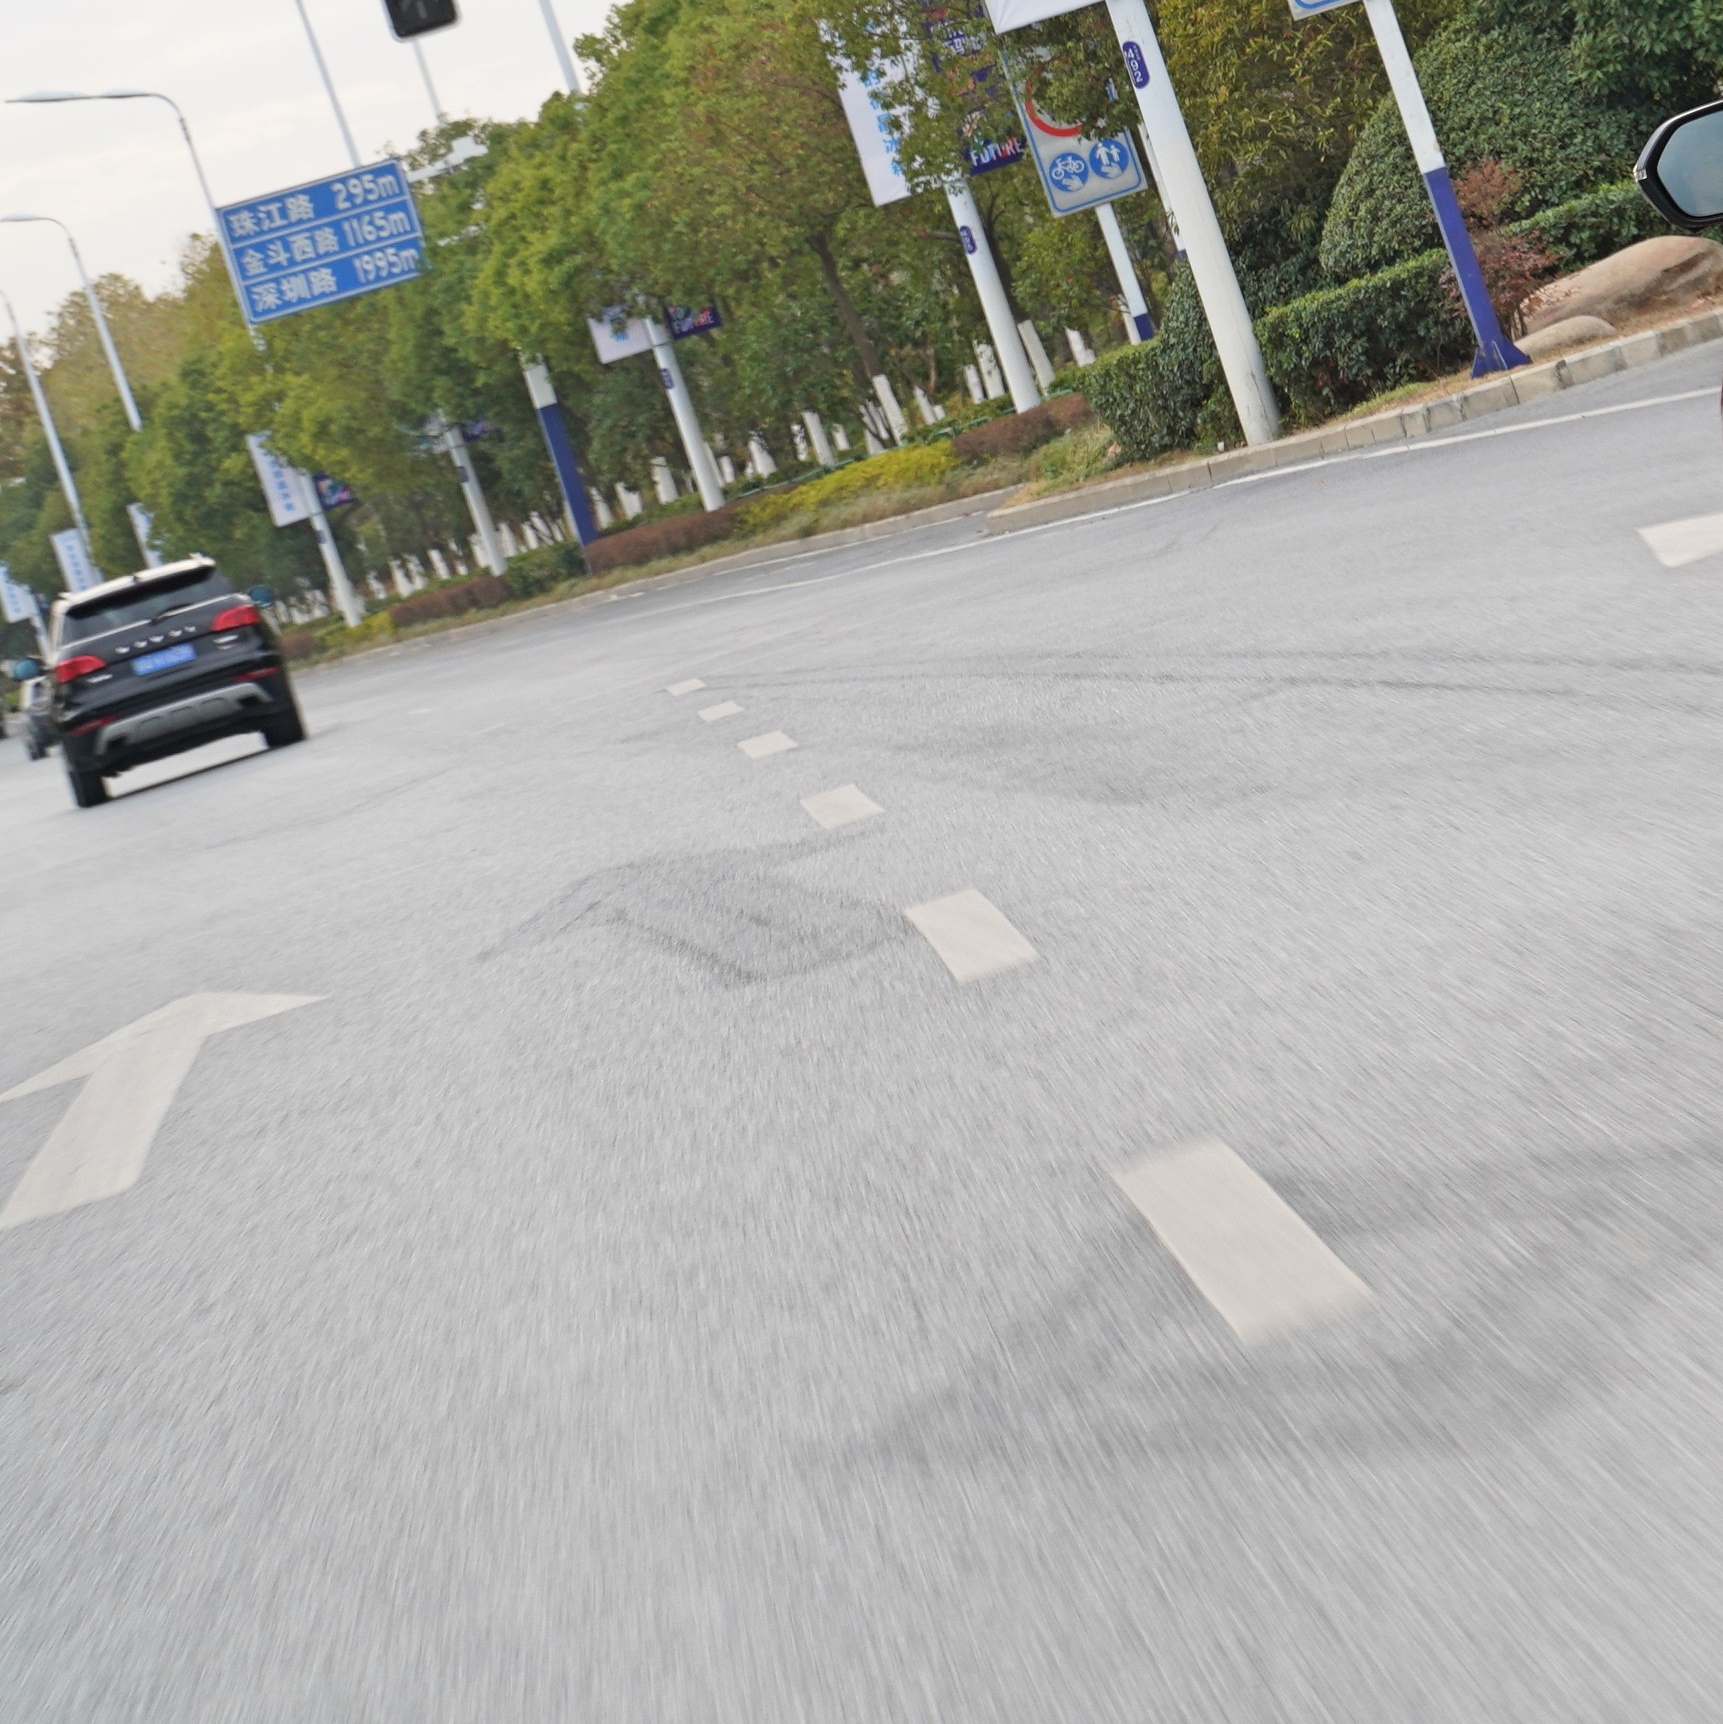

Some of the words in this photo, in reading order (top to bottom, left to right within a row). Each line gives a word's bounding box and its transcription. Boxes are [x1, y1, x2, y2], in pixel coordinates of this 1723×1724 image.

[226, 193, 316, 238] 珠江路
[329, 173, 401, 211] 295m
[341, 210, 412, 248] 1165m
[249, 266, 338, 313] 深圳路
[352, 246, 420, 284] 1995m
